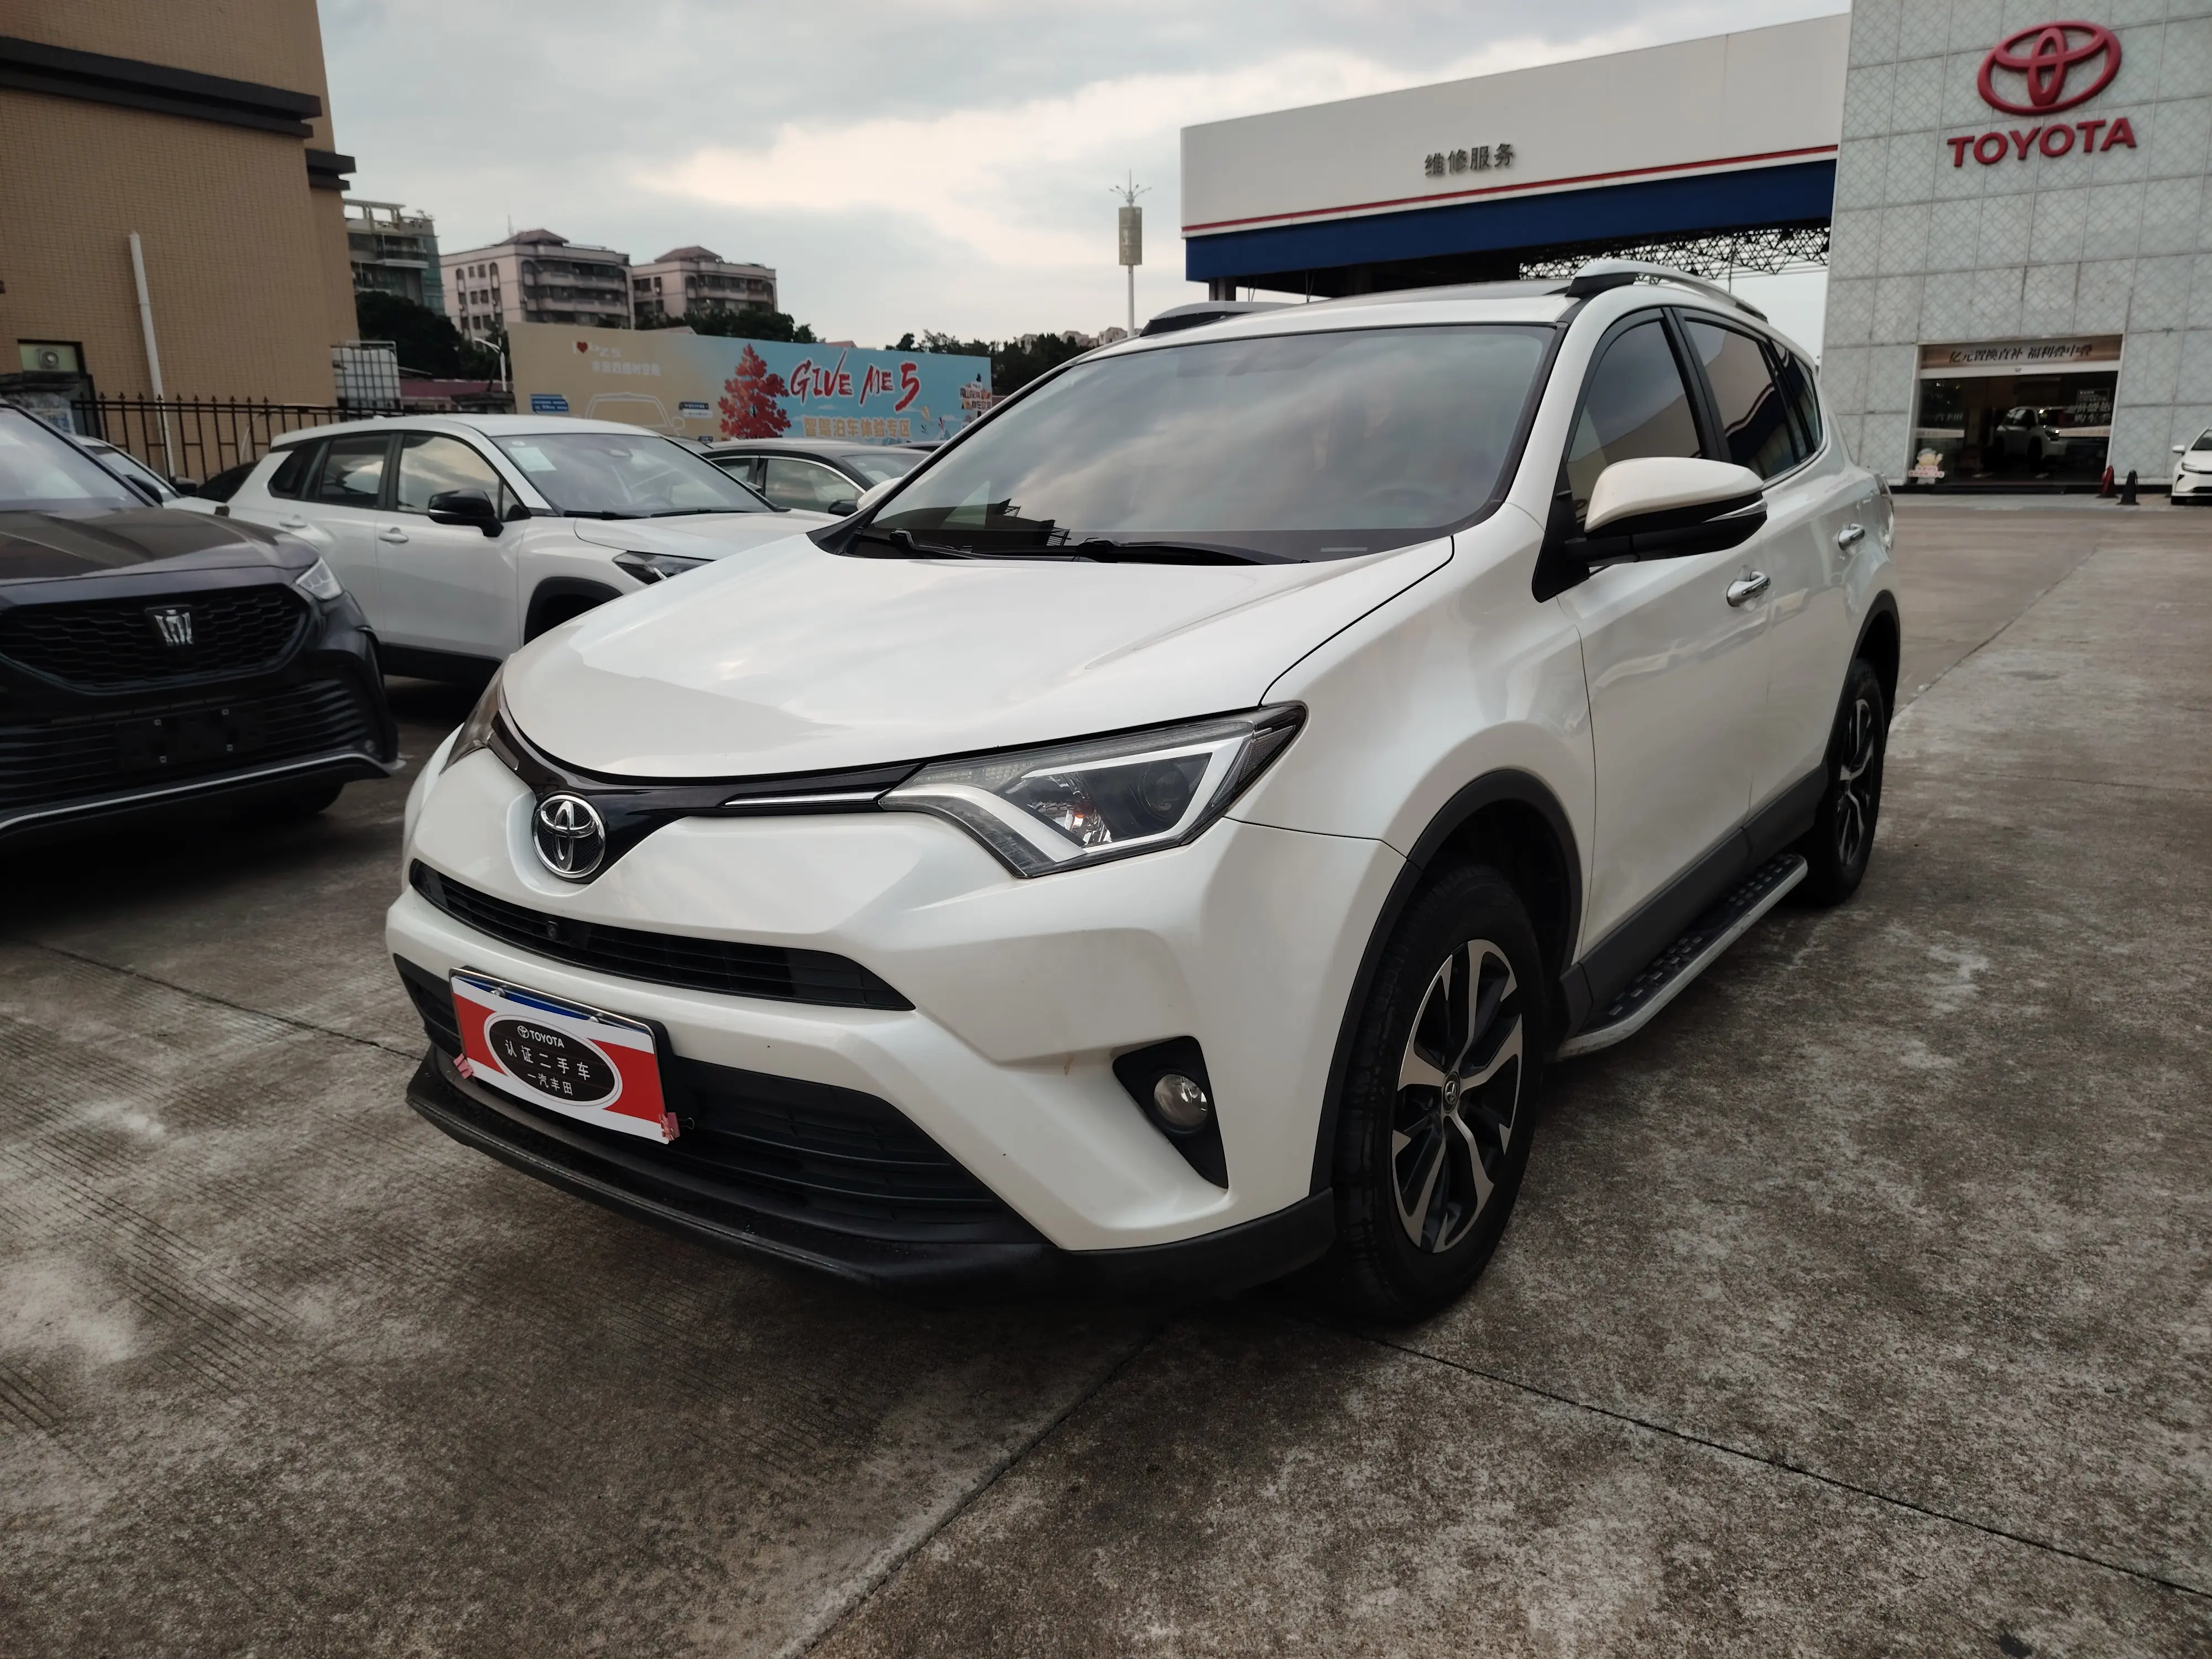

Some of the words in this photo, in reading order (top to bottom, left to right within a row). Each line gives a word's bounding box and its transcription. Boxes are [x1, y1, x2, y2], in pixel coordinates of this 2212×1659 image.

[1947, 117, 2137, 168] TOYOTA
[1424, 143, 1514, 176] 维修服务
[790, 350, 853, 404] GIVE
[860, 364, 894, 405] ME
[895, 362, 920, 412] 5
[804, 418, 911, 438] 智驾泊车体验专区
[529, 1030, 565, 1048] TOYOTA
[504, 1040, 591, 1081] 认证二手车
[527, 1072, 573, 1096] 一汽丰田
